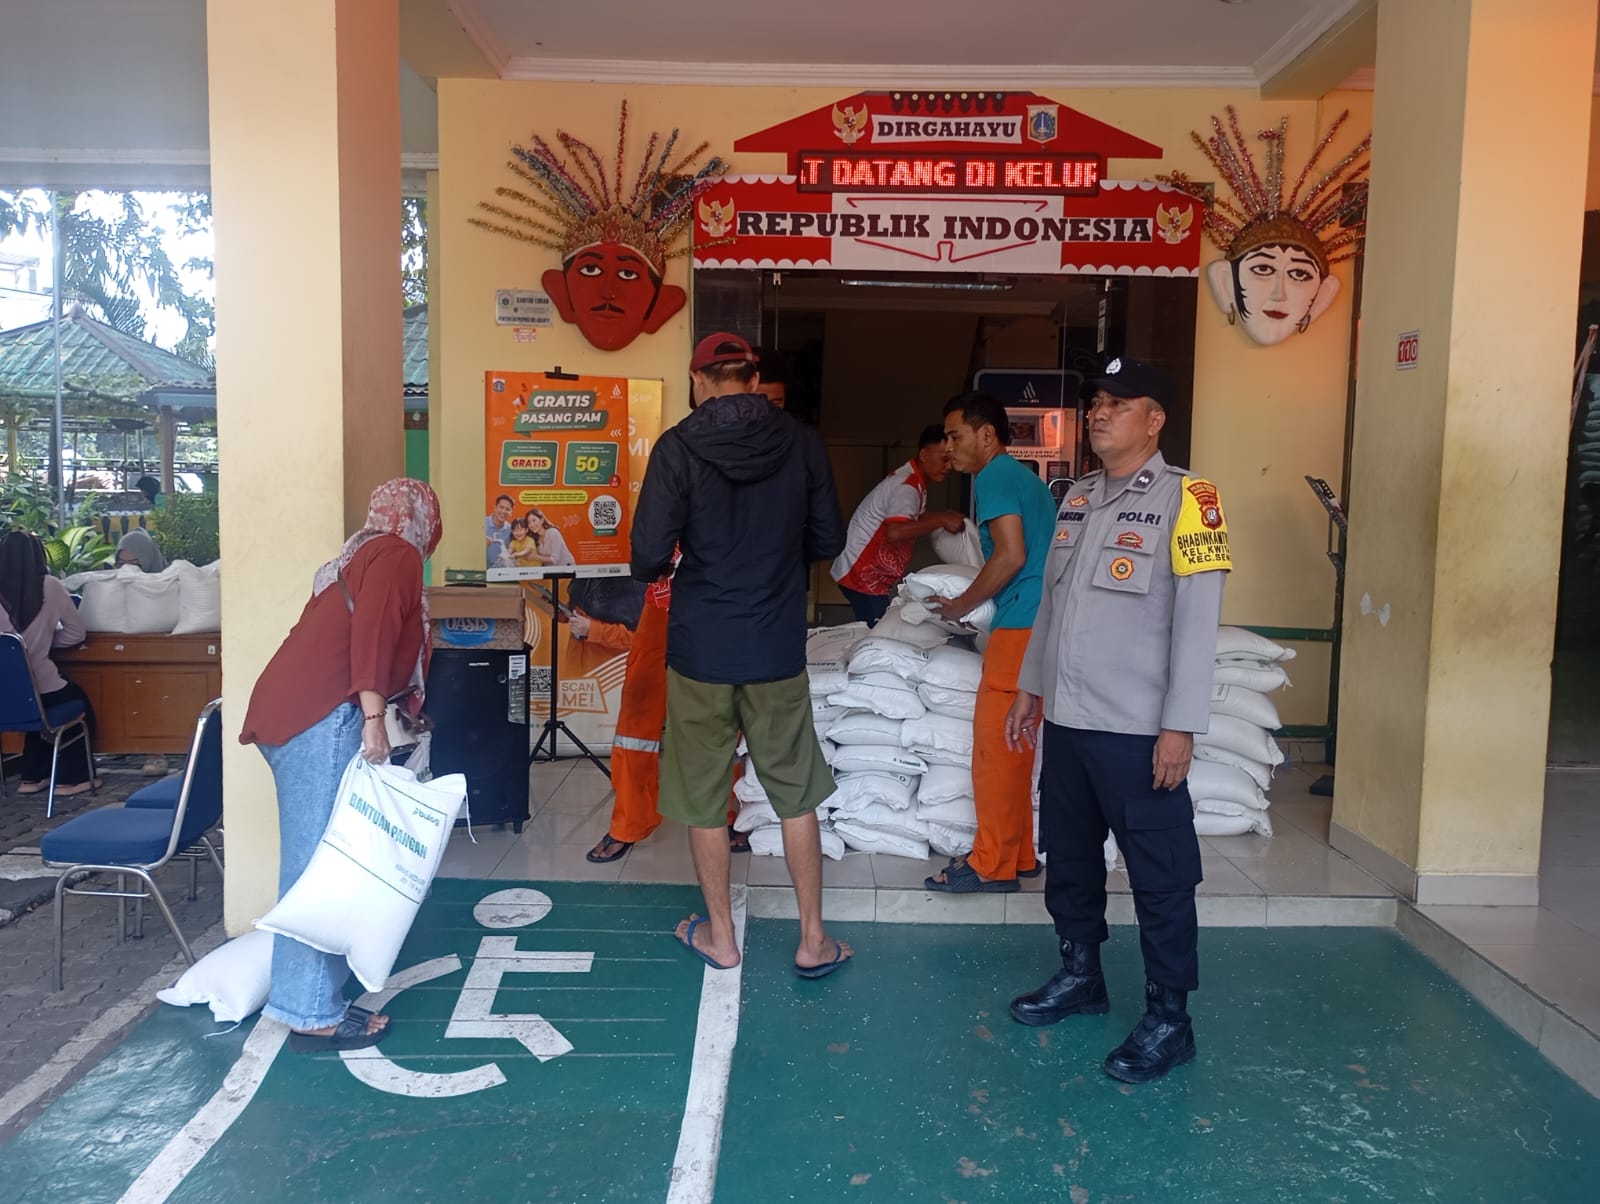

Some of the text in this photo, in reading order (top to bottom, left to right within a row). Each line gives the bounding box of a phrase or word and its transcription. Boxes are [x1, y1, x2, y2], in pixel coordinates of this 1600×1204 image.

[877, 119, 1017, 139] DIRGAHAYU
[801, 159, 824, 185] T
[832, 159, 956, 187] DATANG
[966, 161, 995, 187] DI
[737, 212, 1152, 243] REPUBLIK INDONESIA
[1399, 340, 1417, 361] 110
[533, 394, 591, 408] GRATIS
[520, 412, 602, 424] PASANG PAM
[511, 459, 548, 468] GRATIS
[575, 455, 600, 472] 50
[1117, 511, 1162, 526] POLRI
[445, 618, 489, 632] OASIS
[561, 682, 594, 692] SCAN
[562, 693, 594, 707] ME!
[348, 792, 391, 834] BANTUAN
[390, 825, 428, 860] PANGAN
